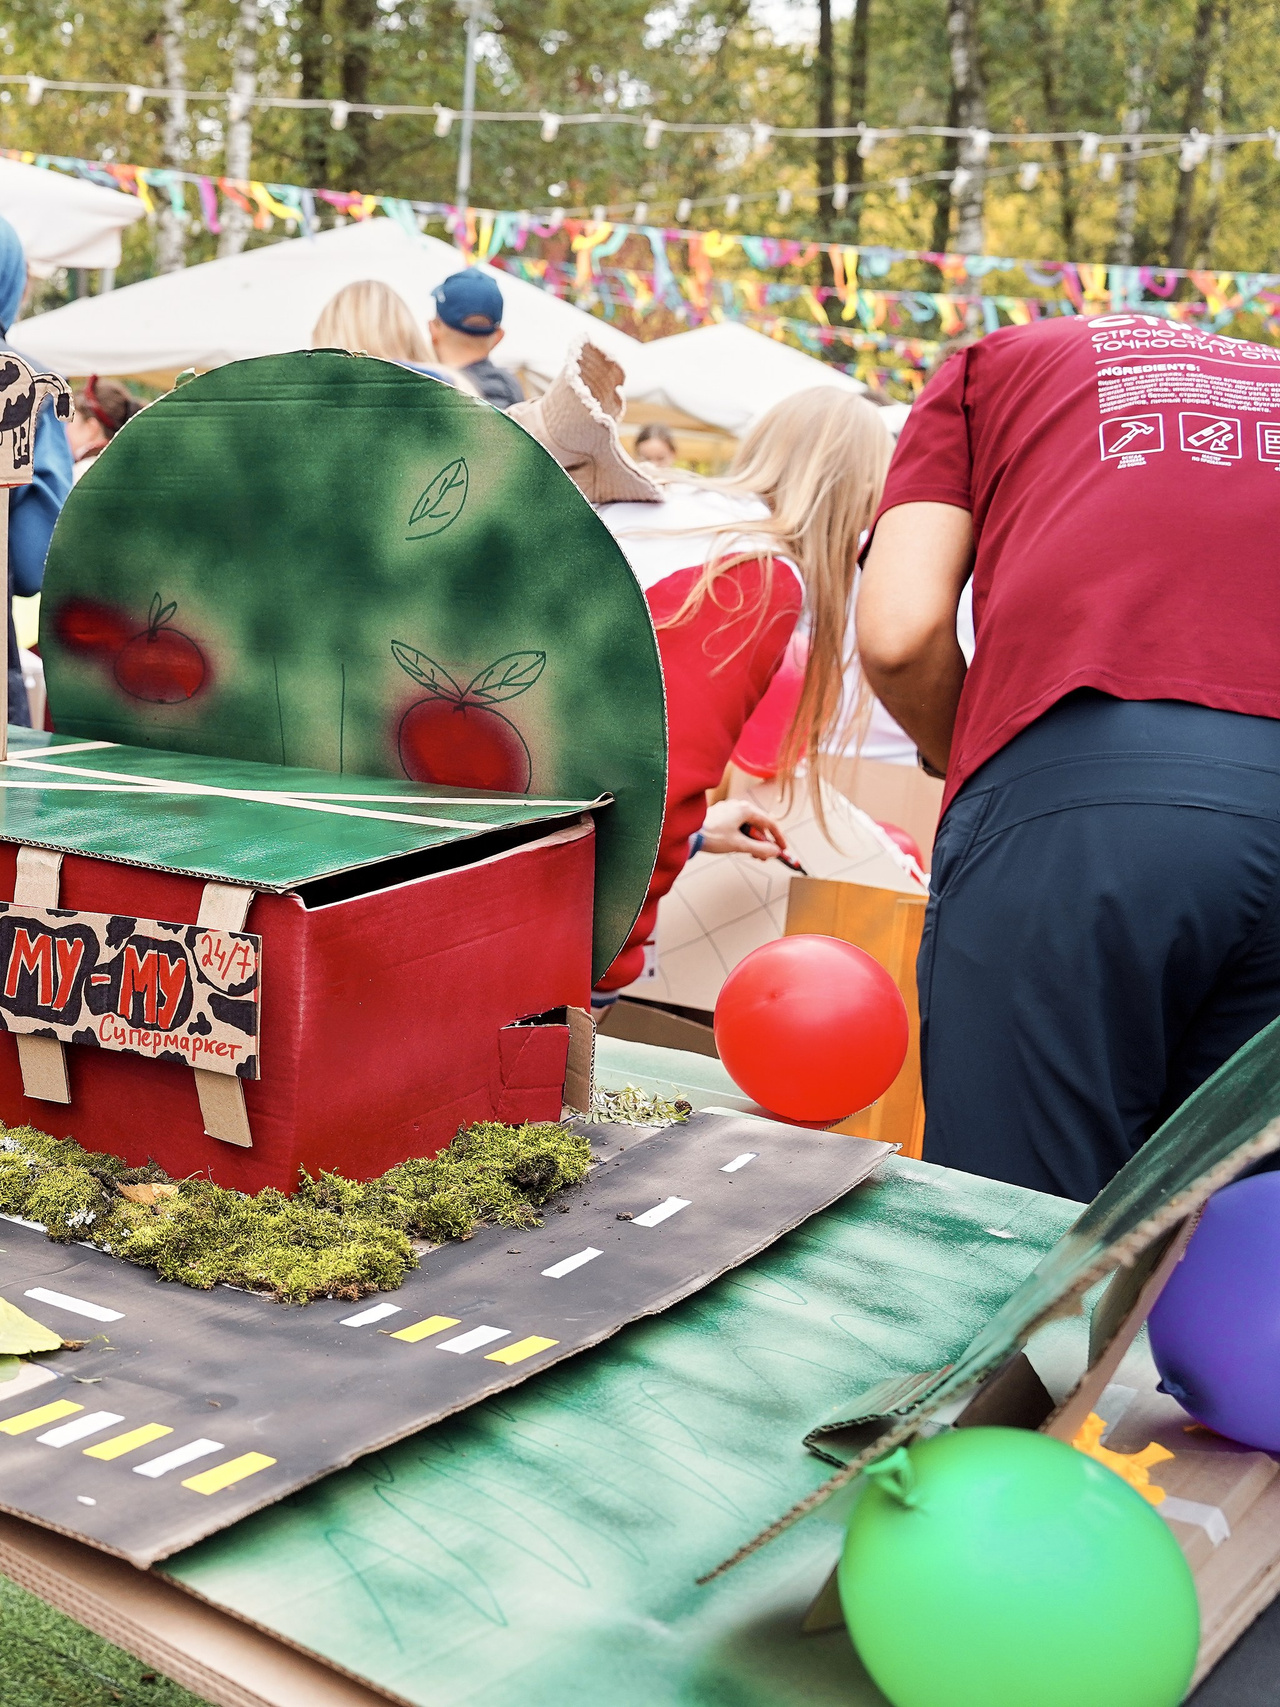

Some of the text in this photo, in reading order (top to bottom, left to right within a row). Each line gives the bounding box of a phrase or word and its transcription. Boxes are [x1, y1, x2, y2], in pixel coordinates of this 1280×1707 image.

[1091, 328, 1176, 343] СТРОЮ
[1092, 338, 1214, 354] ТОЧНОСТИ
[201, 934, 253, 980] 24/7
[99, 1014, 243, 1061] Супермаркет
